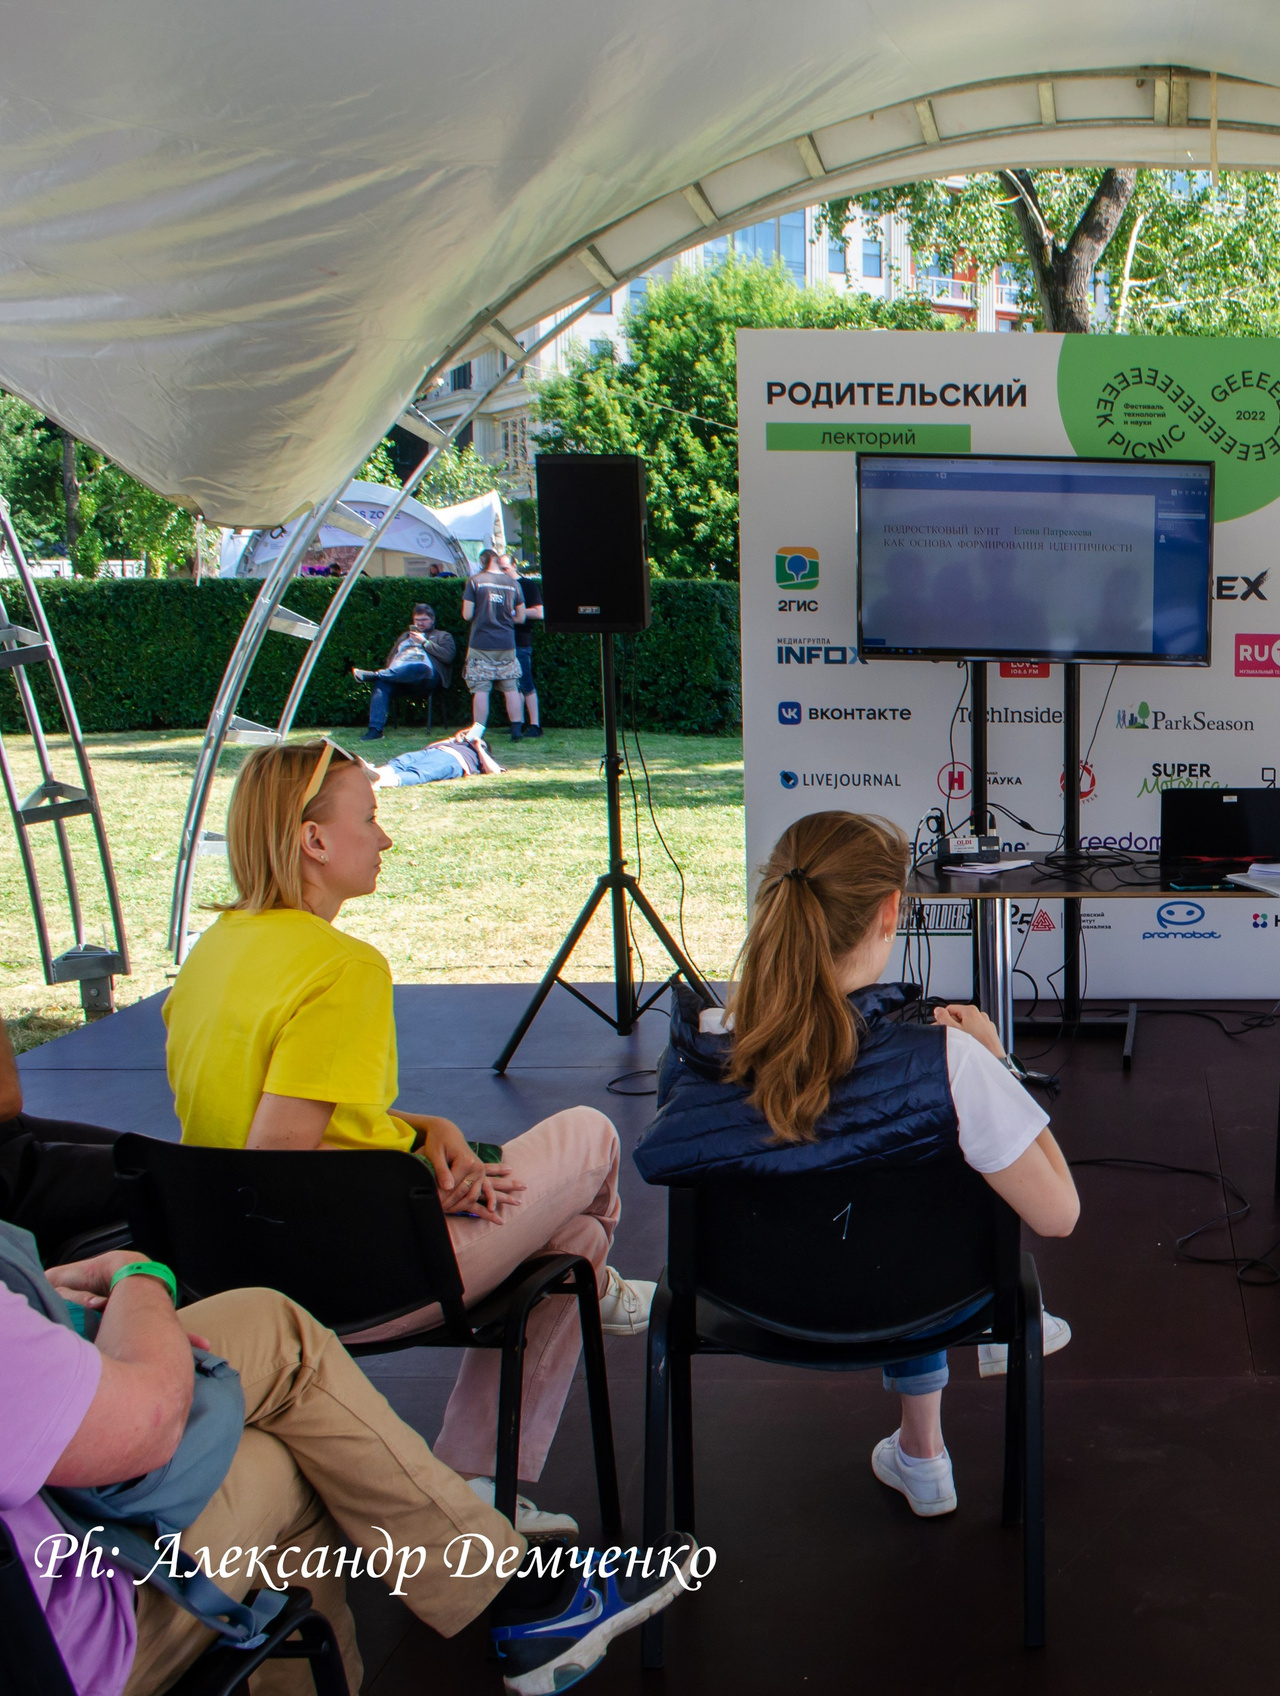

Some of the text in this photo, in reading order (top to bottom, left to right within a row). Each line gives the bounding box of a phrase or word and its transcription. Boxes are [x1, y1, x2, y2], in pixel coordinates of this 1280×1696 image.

[766, 379, 1027, 409] РОДИТЕЛЬСКИЙ
[1123, 411, 1167, 419] технологий
[1235, 410, 1266, 421] 2022
[821, 430, 916, 449] лекторий
[1107, 424, 1186, 460] PICNIC
[883, 524, 969, 535] ПОДРОСТКОВЫЙ
[973, 527, 1000, 536] БУНТ
[1013, 526, 1040, 536] Елена
[883, 538, 1133, 553] КАК ОСНОВА ФОРМИРОВАНИЯ ИДЕНТИЧНОСТИ
[1212, 567, 1271, 601] EX
[778, 600, 819, 612] 2ГИС
[1239, 644, 1269, 661] RU
[1151, 711, 1255, 731] ParkSeason
[1152, 763, 1212, 778] SUPER
[803, 773, 901, 790] LIVEJOURNAL
[1079, 832, 1161, 851] reedom
[922, 904, 970, 929] SOLDIERS
[1142, 930, 1221, 940] promobot
